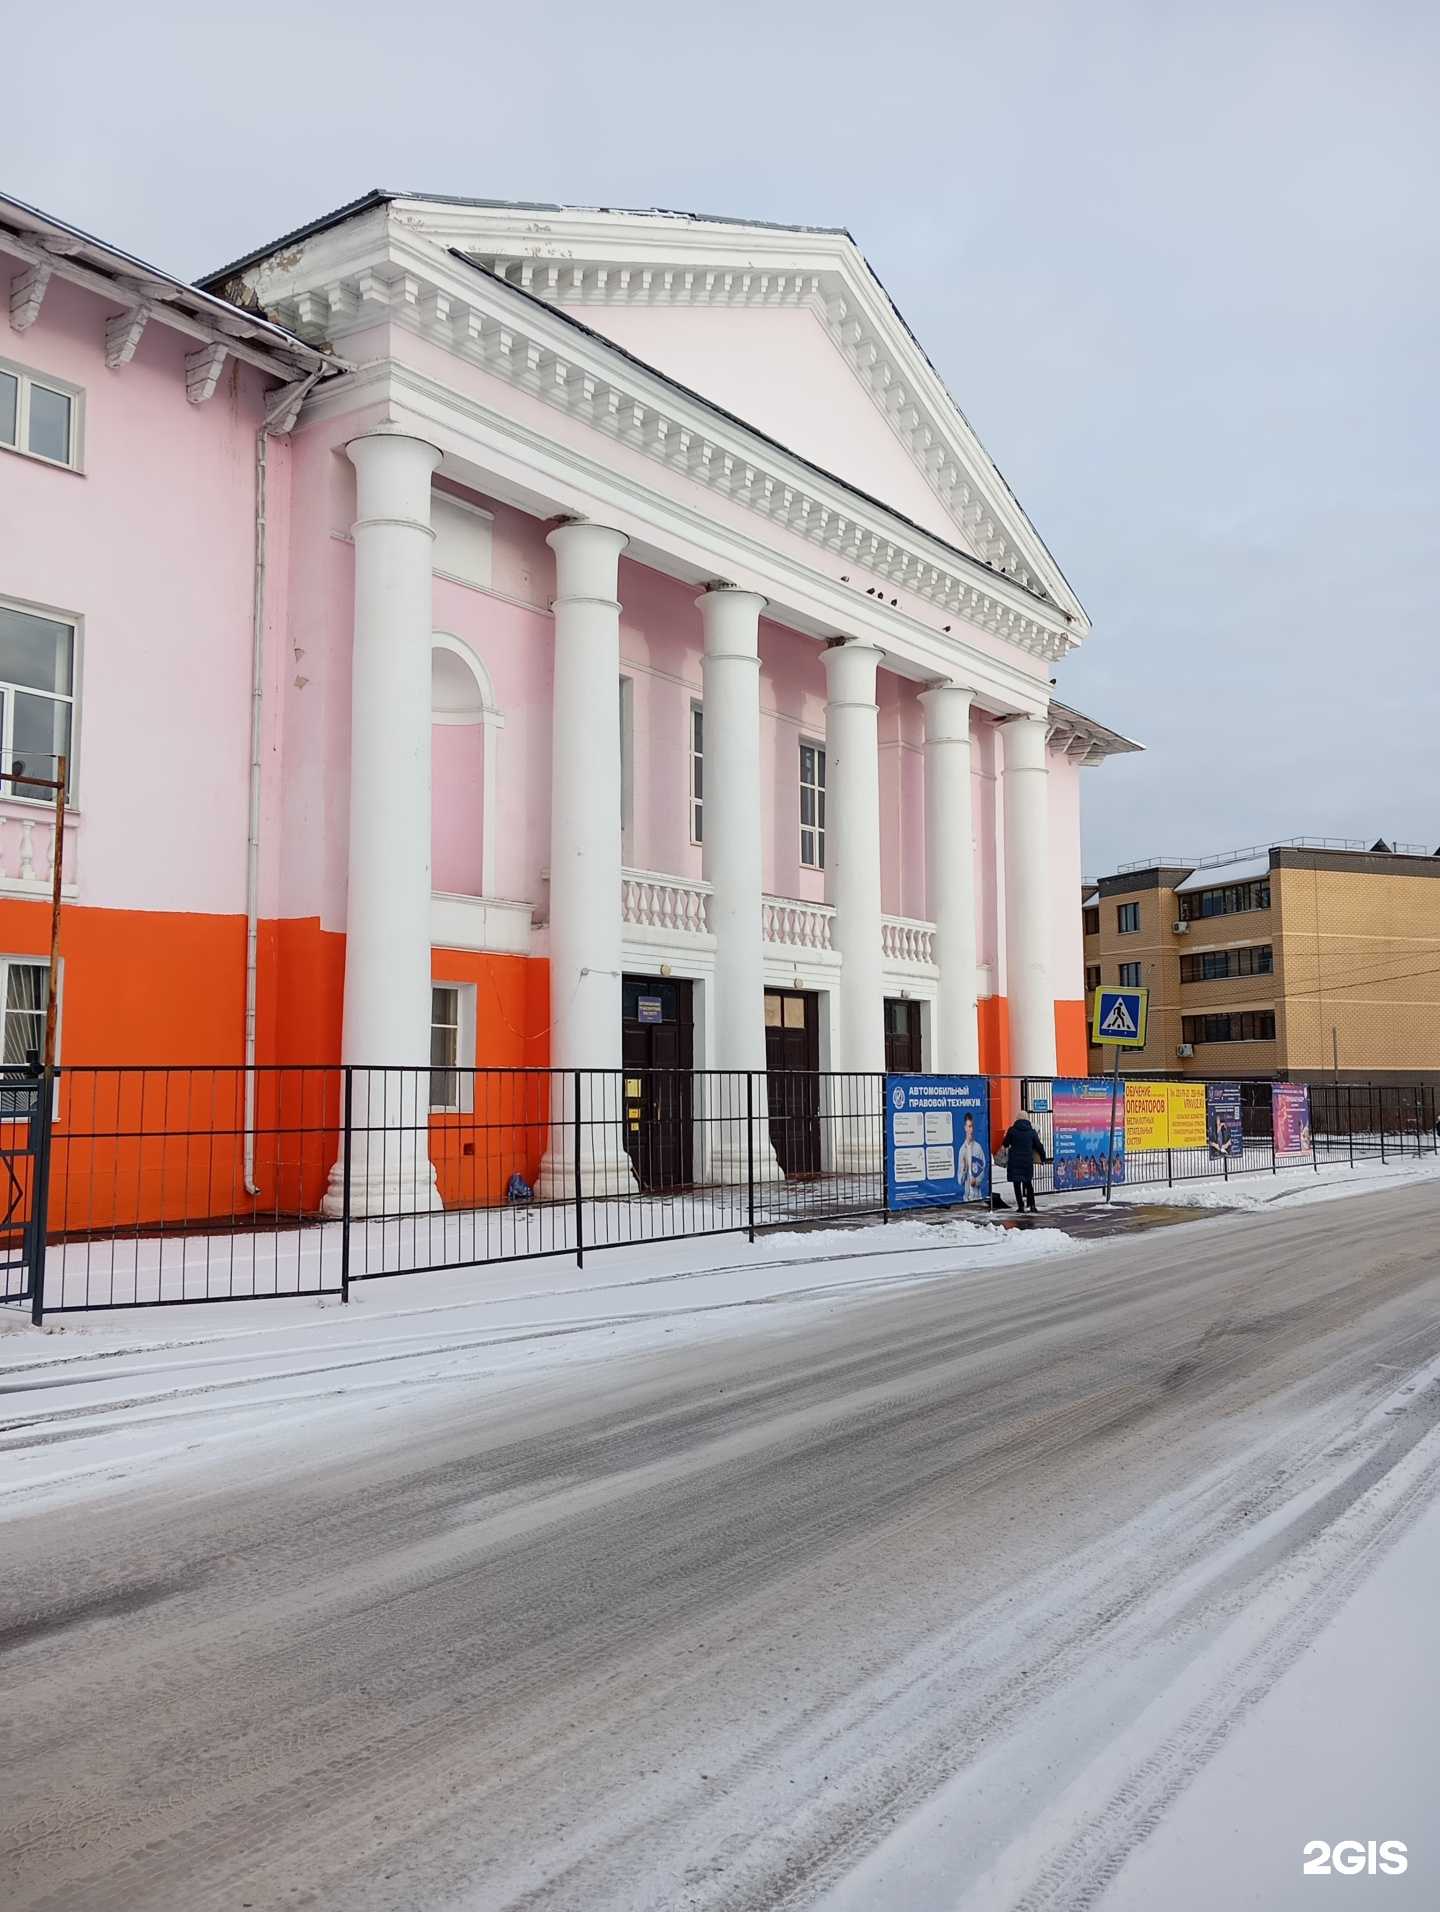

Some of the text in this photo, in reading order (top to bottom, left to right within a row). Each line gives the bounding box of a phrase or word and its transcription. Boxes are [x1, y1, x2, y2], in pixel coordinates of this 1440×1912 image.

[908, 1085, 969, 1096] АВТОМОБИЛЬНЫЙ
[1126, 1086, 1151, 1097] ОБУЧЕНИЕ
[908, 1097, 981, 1107] ПРАВОВОЙ ТЕХНИКУМ
[1126, 1099, 1165, 1113] ОПЕРАТОРОВ
